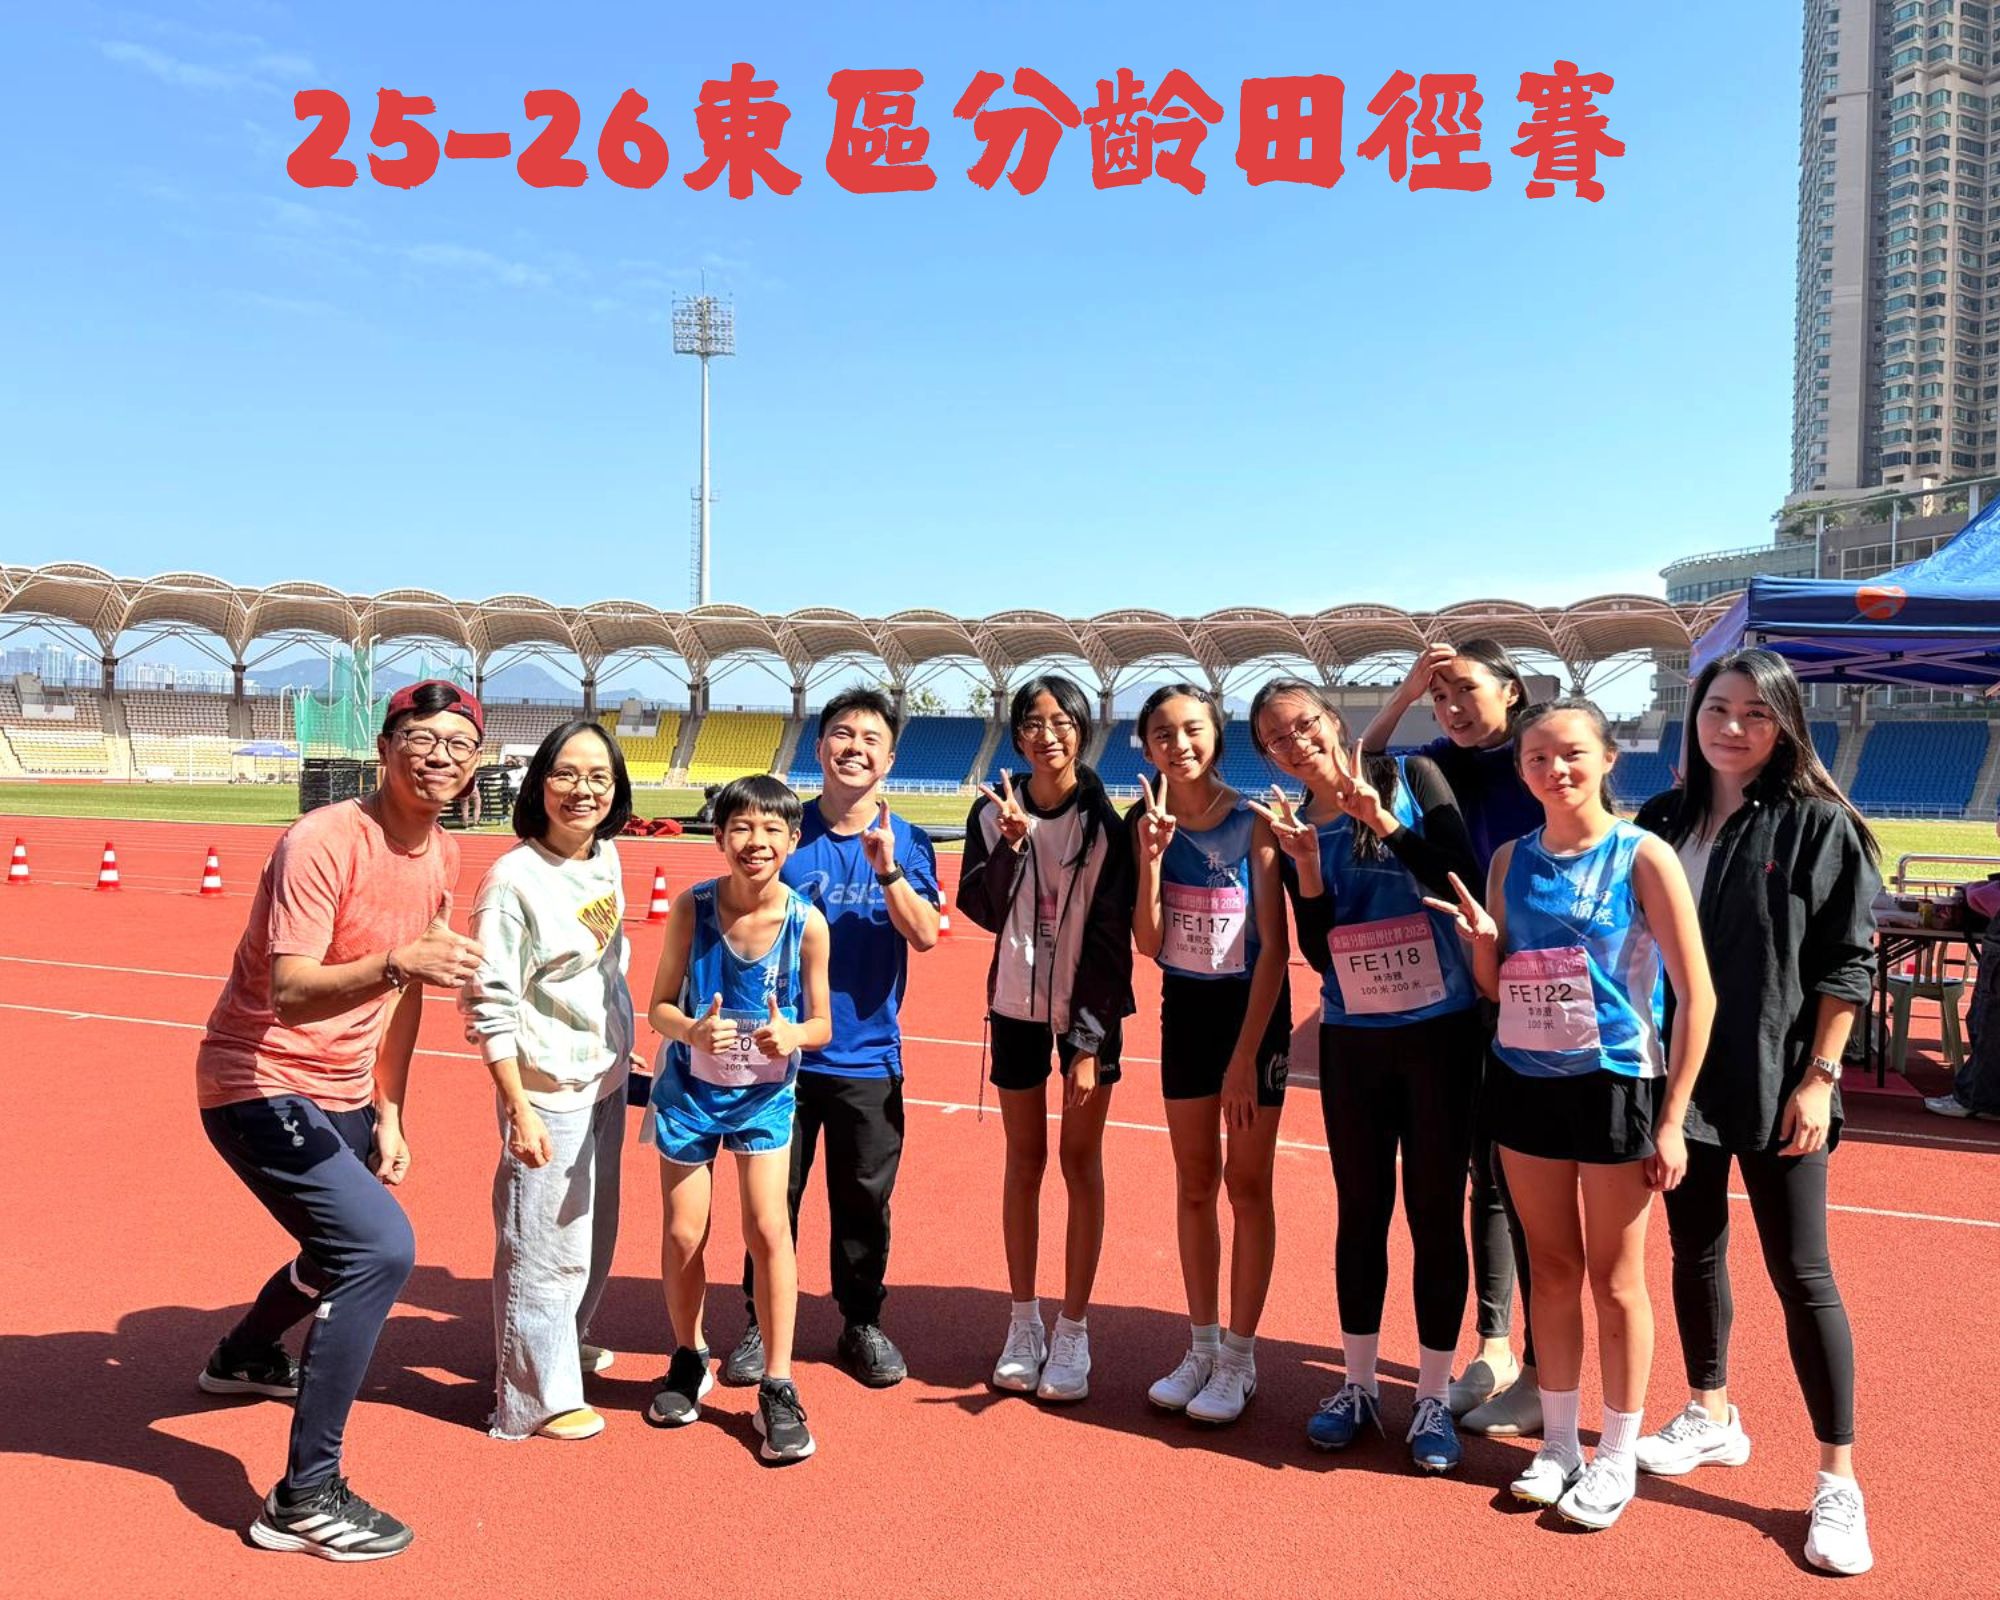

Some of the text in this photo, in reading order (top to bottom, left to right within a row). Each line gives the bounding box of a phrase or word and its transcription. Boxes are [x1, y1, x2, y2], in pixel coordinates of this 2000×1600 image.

[1172, 912, 1230, 934] FE117
[1404, 922, 1429, 938] 2025
[1349, 947, 1421, 973] FE118
[1361, 985, 1378, 996] 100
[1392, 982, 1409, 993] 200
[1508, 983, 1574, 1003] FE122
[725, 1063, 741, 1072] 100
